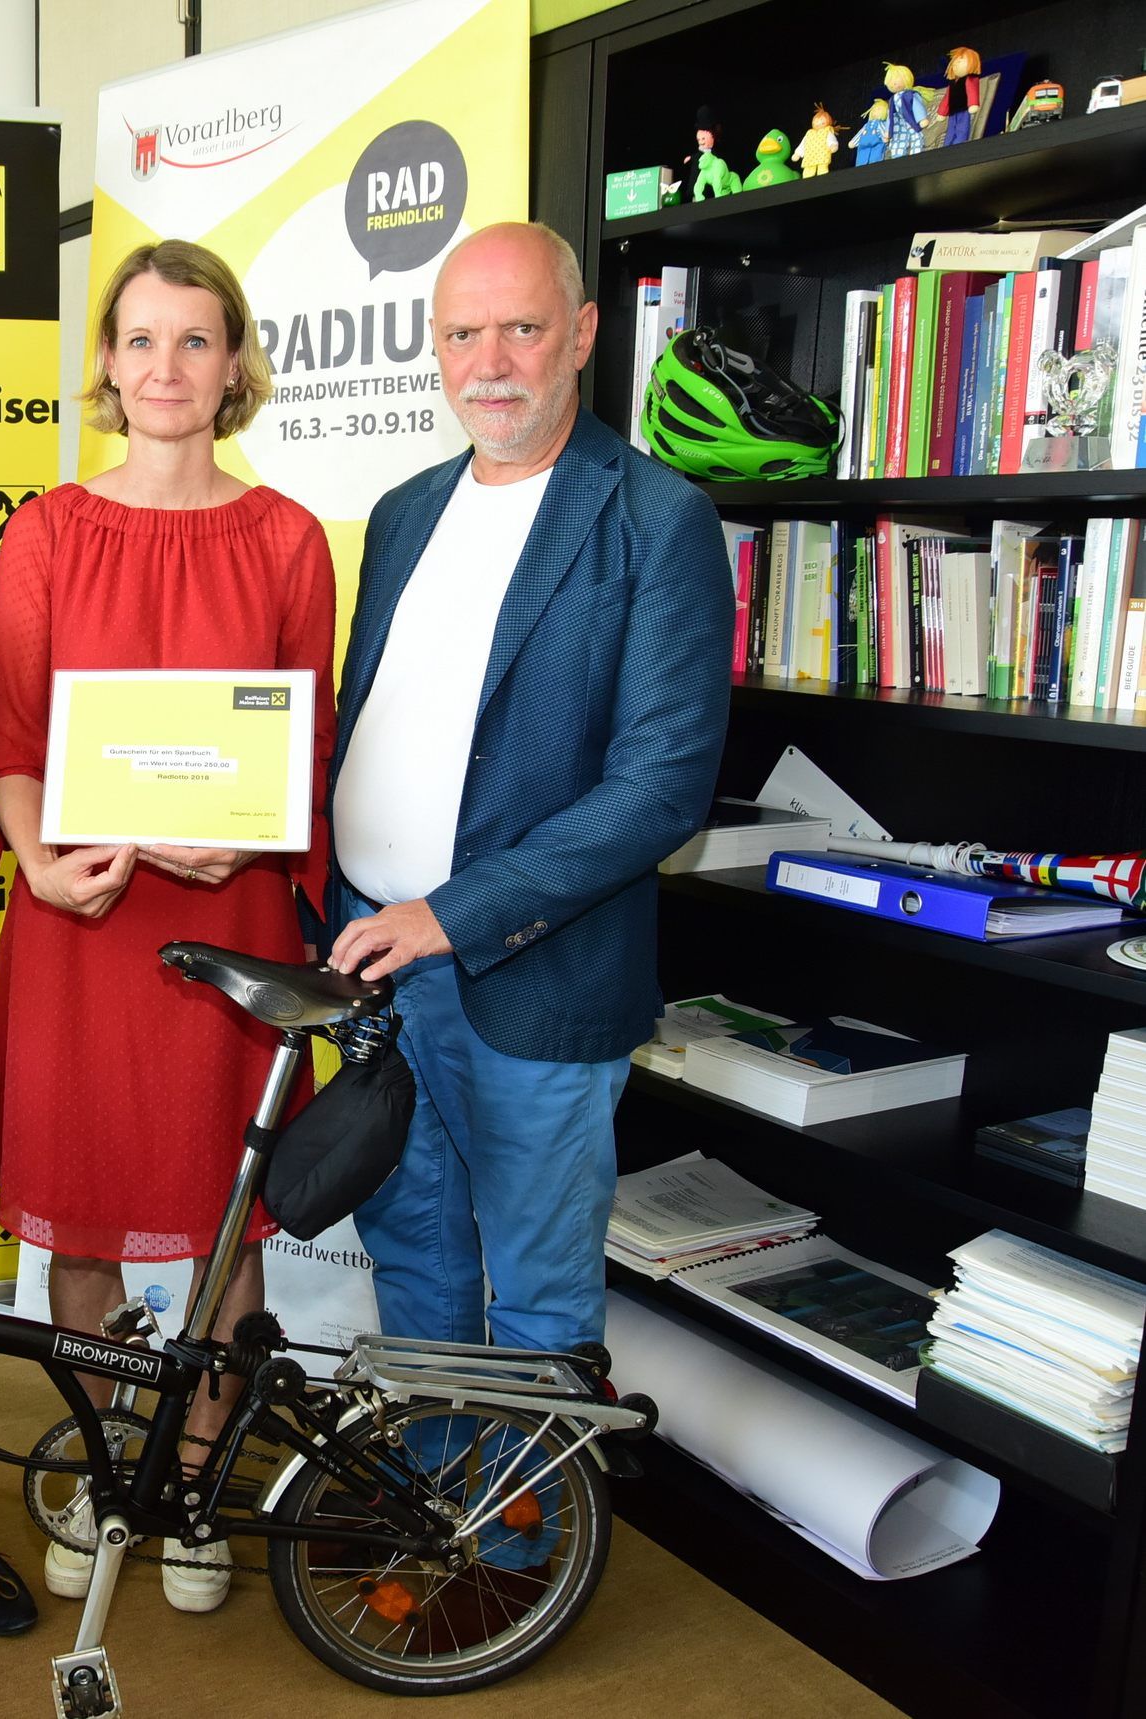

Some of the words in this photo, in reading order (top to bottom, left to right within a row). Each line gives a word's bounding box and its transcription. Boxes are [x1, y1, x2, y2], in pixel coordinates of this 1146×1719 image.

[165, 102, 282, 148] Vorarlberg
[192, 141, 219, 156] unser
[222, 135, 245, 152] Land
[366, 161, 445, 215] RAD
[366, 204, 444, 232] FREUNDLICH
[936, 245, 976, 257] ATATÜRK
[255, 298, 437, 375] RADIU
[1014, 294, 1028, 362] druckerstrahl
[980, 402, 988, 424] Schule
[979, 425, 988, 448] mündige
[912, 553, 920, 576] SHORT
[1060, 548, 1067, 556] 3
[774, 553, 783, 606] VORARLBERGS
[772, 608, 780, 642] ZUKUNFT
[1126, 645, 1135, 670] GUIDE
[1124, 671, 1132, 690] BIER
[61, 1340, 154, 1375] BROMPTON
